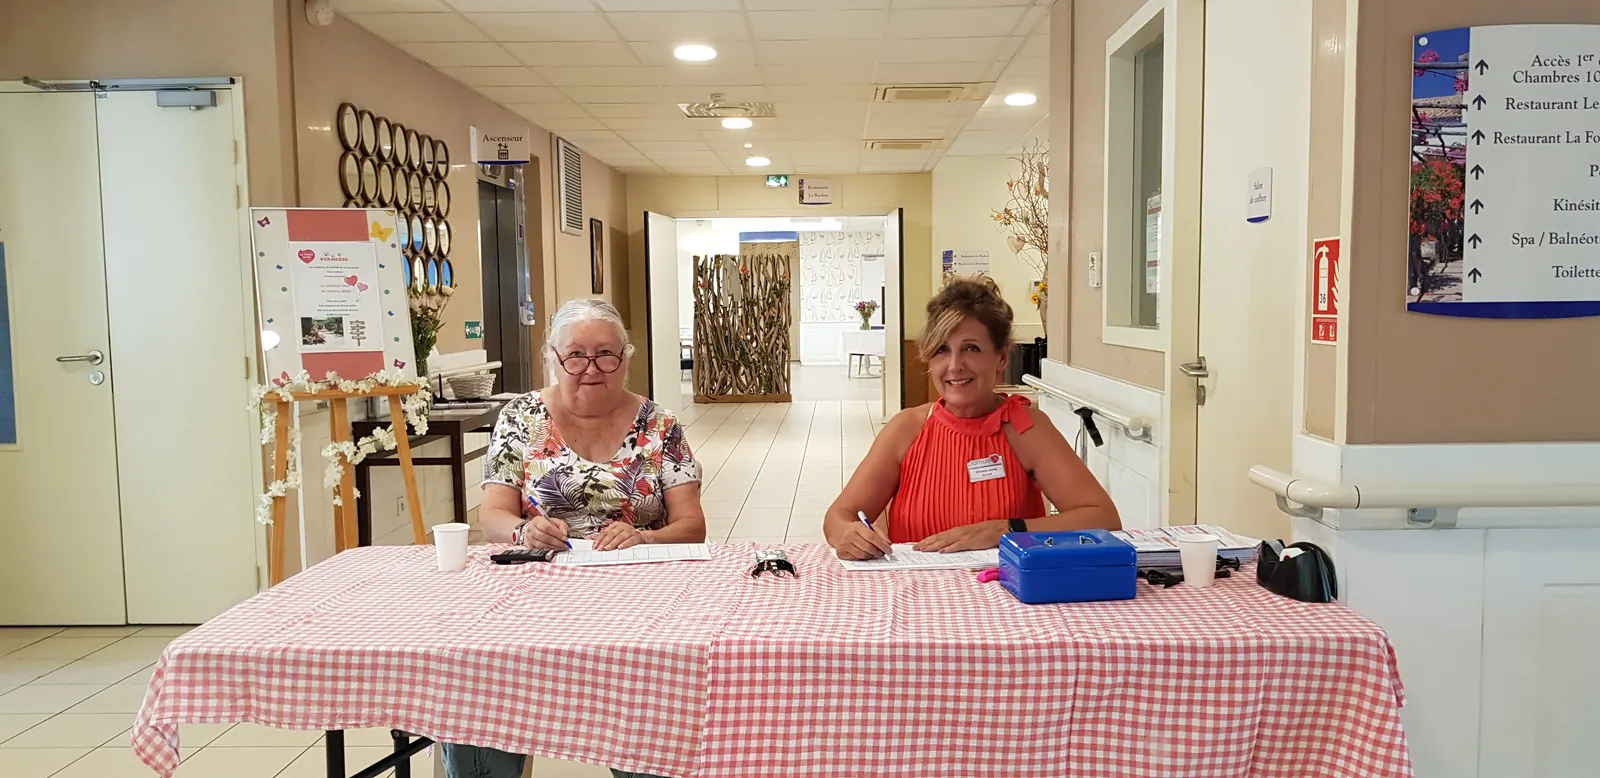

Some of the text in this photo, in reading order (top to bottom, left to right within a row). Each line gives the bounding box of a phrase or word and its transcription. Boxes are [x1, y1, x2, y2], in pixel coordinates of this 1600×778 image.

[1531, 54, 1571, 67] Accès
[1512, 70, 1580, 83] Chambres
[1505, 97, 1599, 110] Restaurant Le
[482, 134, 523, 142] Ascenseur
[1494, 132, 1561, 144] Restaurant
[1566, 131, 1580, 144] La
[1590, 164, 1600, 177] P
[1553, 198, 1600, 211] Kinésit
[1512, 232, 1535, 248] Spa
[1549, 232, 1600, 244] Balnéot
[1552, 265, 1600, 278] Toilette
